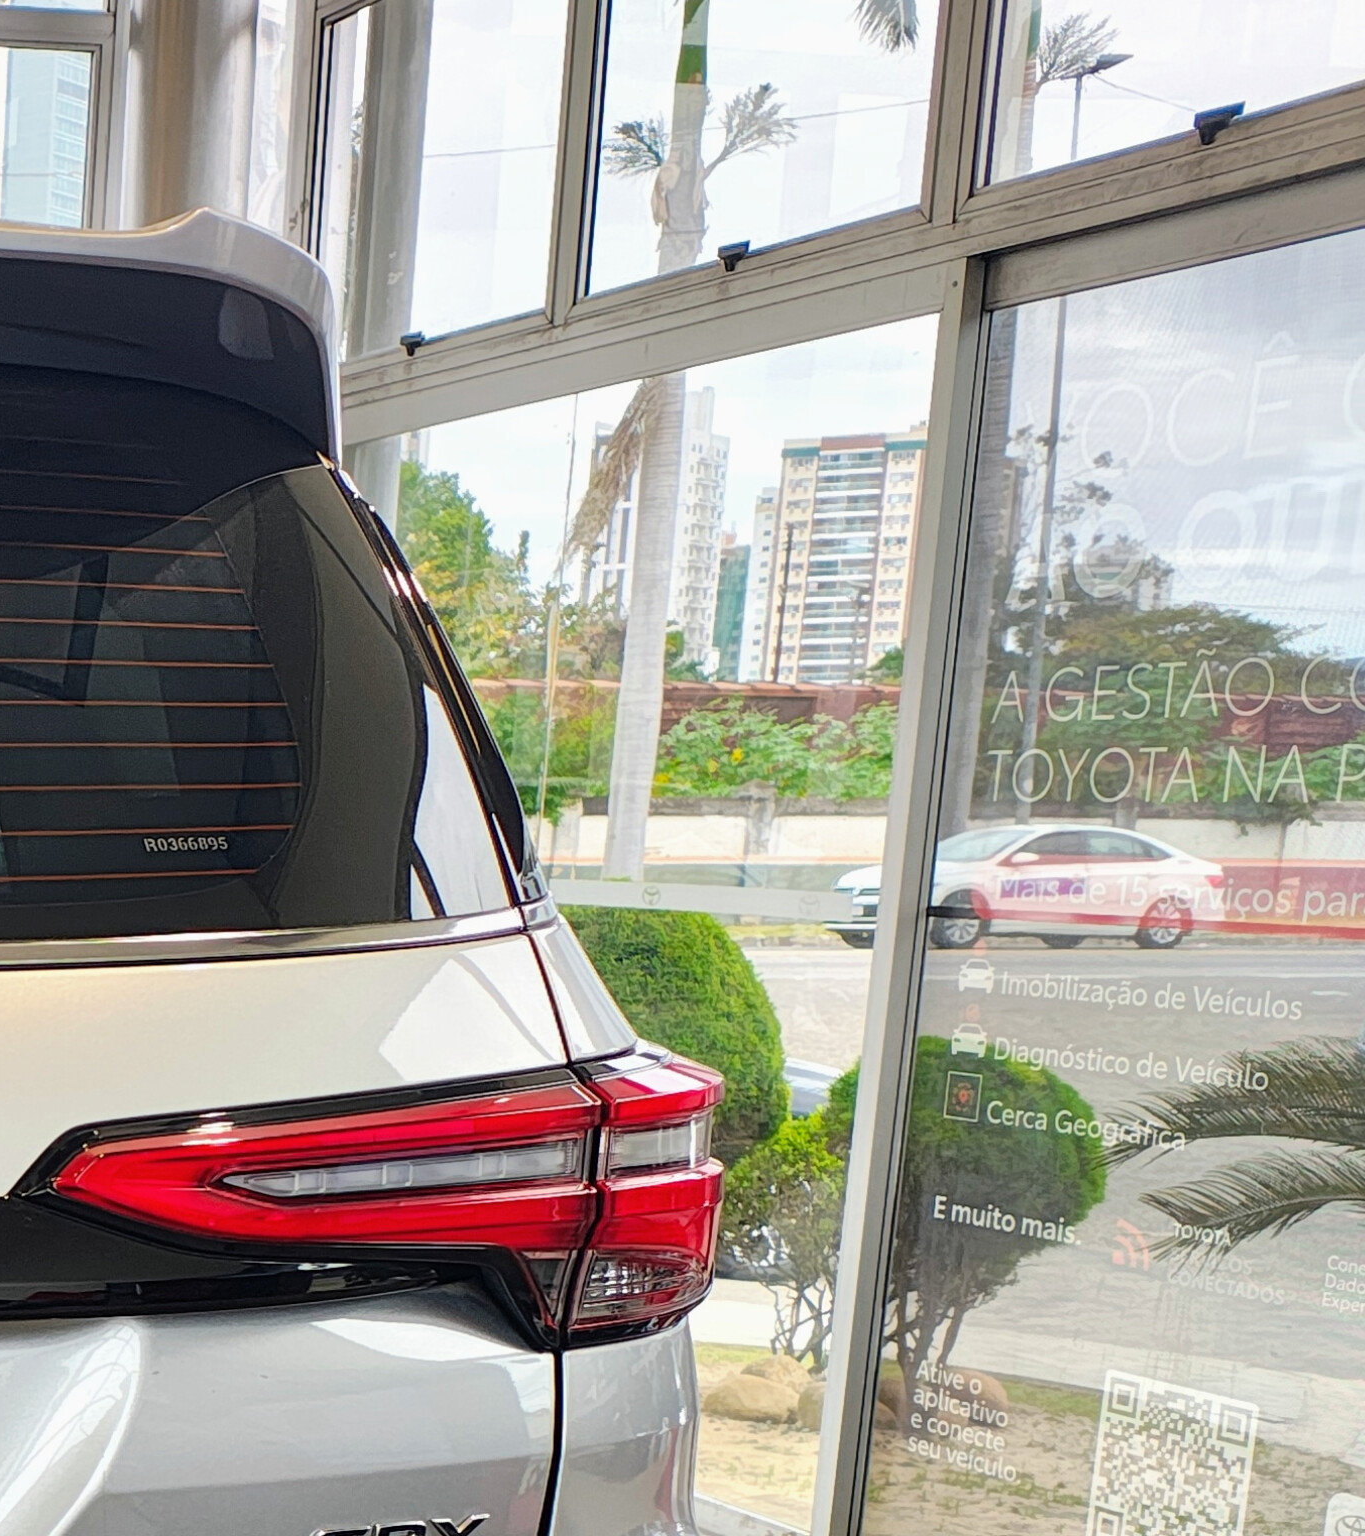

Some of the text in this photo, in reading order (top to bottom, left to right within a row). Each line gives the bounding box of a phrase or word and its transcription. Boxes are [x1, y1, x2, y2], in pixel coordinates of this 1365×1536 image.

[991, 670, 1024, 723] A
[1045, 648, 1275, 722] GESTÃO
[988, 746, 1199, 803] TOYOTA
[1223, 744, 1309, 804] NA
[143, 836, 228, 852] R0366895
[996, 874, 1365, 925] Mais de 15 serviços par
[1001, 971, 1303, 1020] Imobilização de Veículos
[994, 1037, 1269, 1091] Diagnóstico de Veículo
[986, 1100, 1186, 1151] Cerca Geográfica
[933, 1195, 1082, 1246] E muito mais.
[1173, 1223, 1232, 1245] TOYOTA
[1167, 1269, 1285, 1305] CONECTADOS
[915, 1360, 982, 1395] Ative o
[913, 1388, 1008, 1427] aplicativo
[908, 1436, 941, 1460] seu
[911, 1412, 1006, 1452] e conecte
